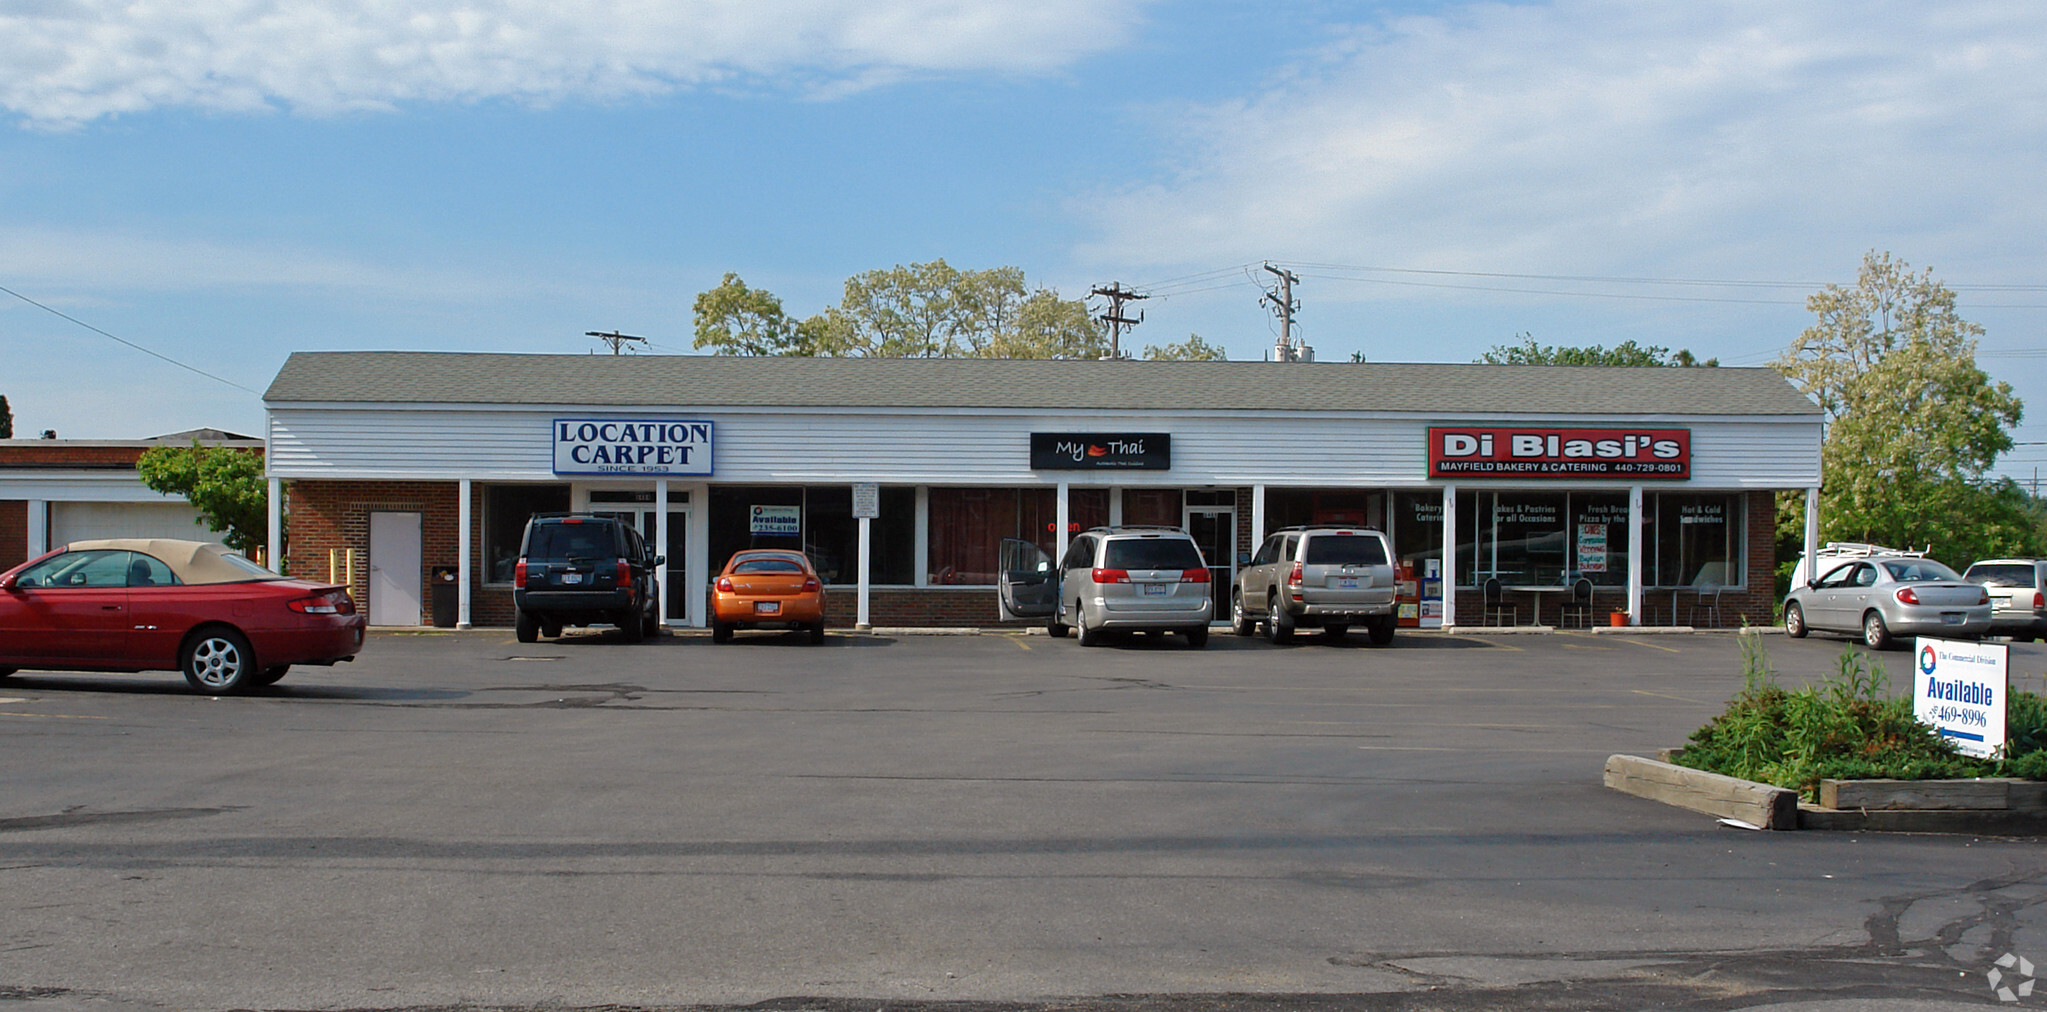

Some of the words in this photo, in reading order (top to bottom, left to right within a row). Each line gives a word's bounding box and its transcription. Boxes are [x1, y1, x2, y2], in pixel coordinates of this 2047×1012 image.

[559, 423, 709, 443] LOCATION
[1055, 441, 1084, 461] My
[1107, 439, 1145, 455] Thai
[1443, 434, 1494, 457] Di
[1511, 434, 1680, 458] Blasi's
[571, 445, 695, 464] CARPET
[1440, 462, 1494, 471] MAYFIELD
[1496, 462, 1539, 471] BAKERY
[1541, 463, 1549, 471] &
[1550, 463, 1607, 472] CATERING
[1614, 463, 1682, 472] 440-729-0801
[1415, 503, 1442, 513] Bakery
[1495, 504, 1515, 512] akes
[1517, 504, 1522, 512] &
[1525, 504, 1556, 512] Pastries
[1588, 504, 1609, 513] Fresh
[1681, 505, 1695, 513] Hot
[1697, 505, 1703, 513] &
[1704, 504, 1721, 513] Cold
[752, 515, 797, 524] Available
[1506, 513, 1517, 522] all
[1519, 513, 1556, 522] Occasions
[1579, 513, 1600, 522] Pizza
[1602, 513, 1612, 524] by
[1613, 513, 1625, 522] the
[1047, 522, 1081, 534] oen
[1939, 651, 1947, 660] The
[1948, 652, 1976, 663] Commercial
[1977, 655, 1996, 665] Division
[1927, 677, 1992, 706] Available
[1938, 706, 1987, 728] 469-8996
